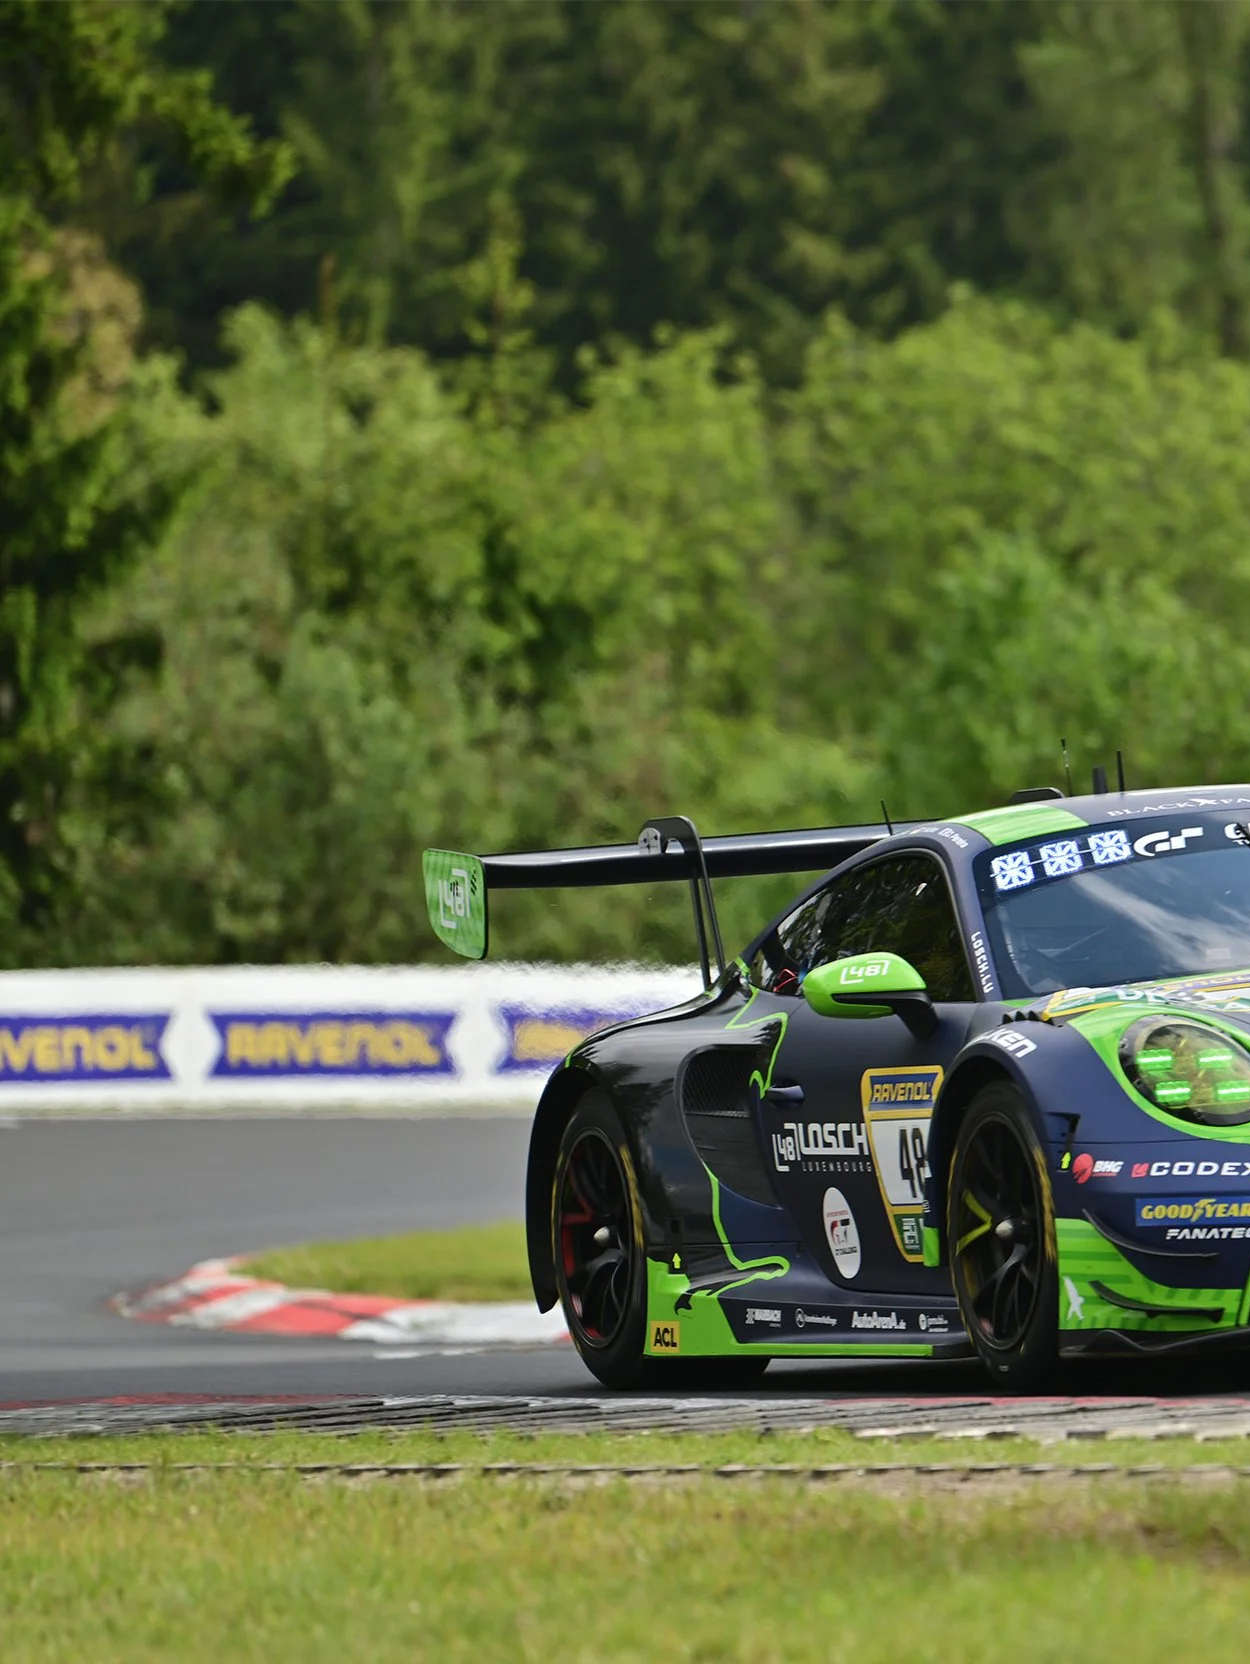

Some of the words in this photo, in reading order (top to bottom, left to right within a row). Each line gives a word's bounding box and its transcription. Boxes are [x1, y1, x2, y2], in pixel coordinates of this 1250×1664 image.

[1107, 800, 1195, 817] BLACK
[971, 931, 995, 994] LOSCH.LU
[0, 1025, 157, 1073] VENOL
[872, 1082, 932, 1103] RAVENOL
[798, 1123, 869, 1155] LOSCH
[802, 1161, 873, 1172] LUXEMBOURG
[653, 1327, 677, 1347] ACL
